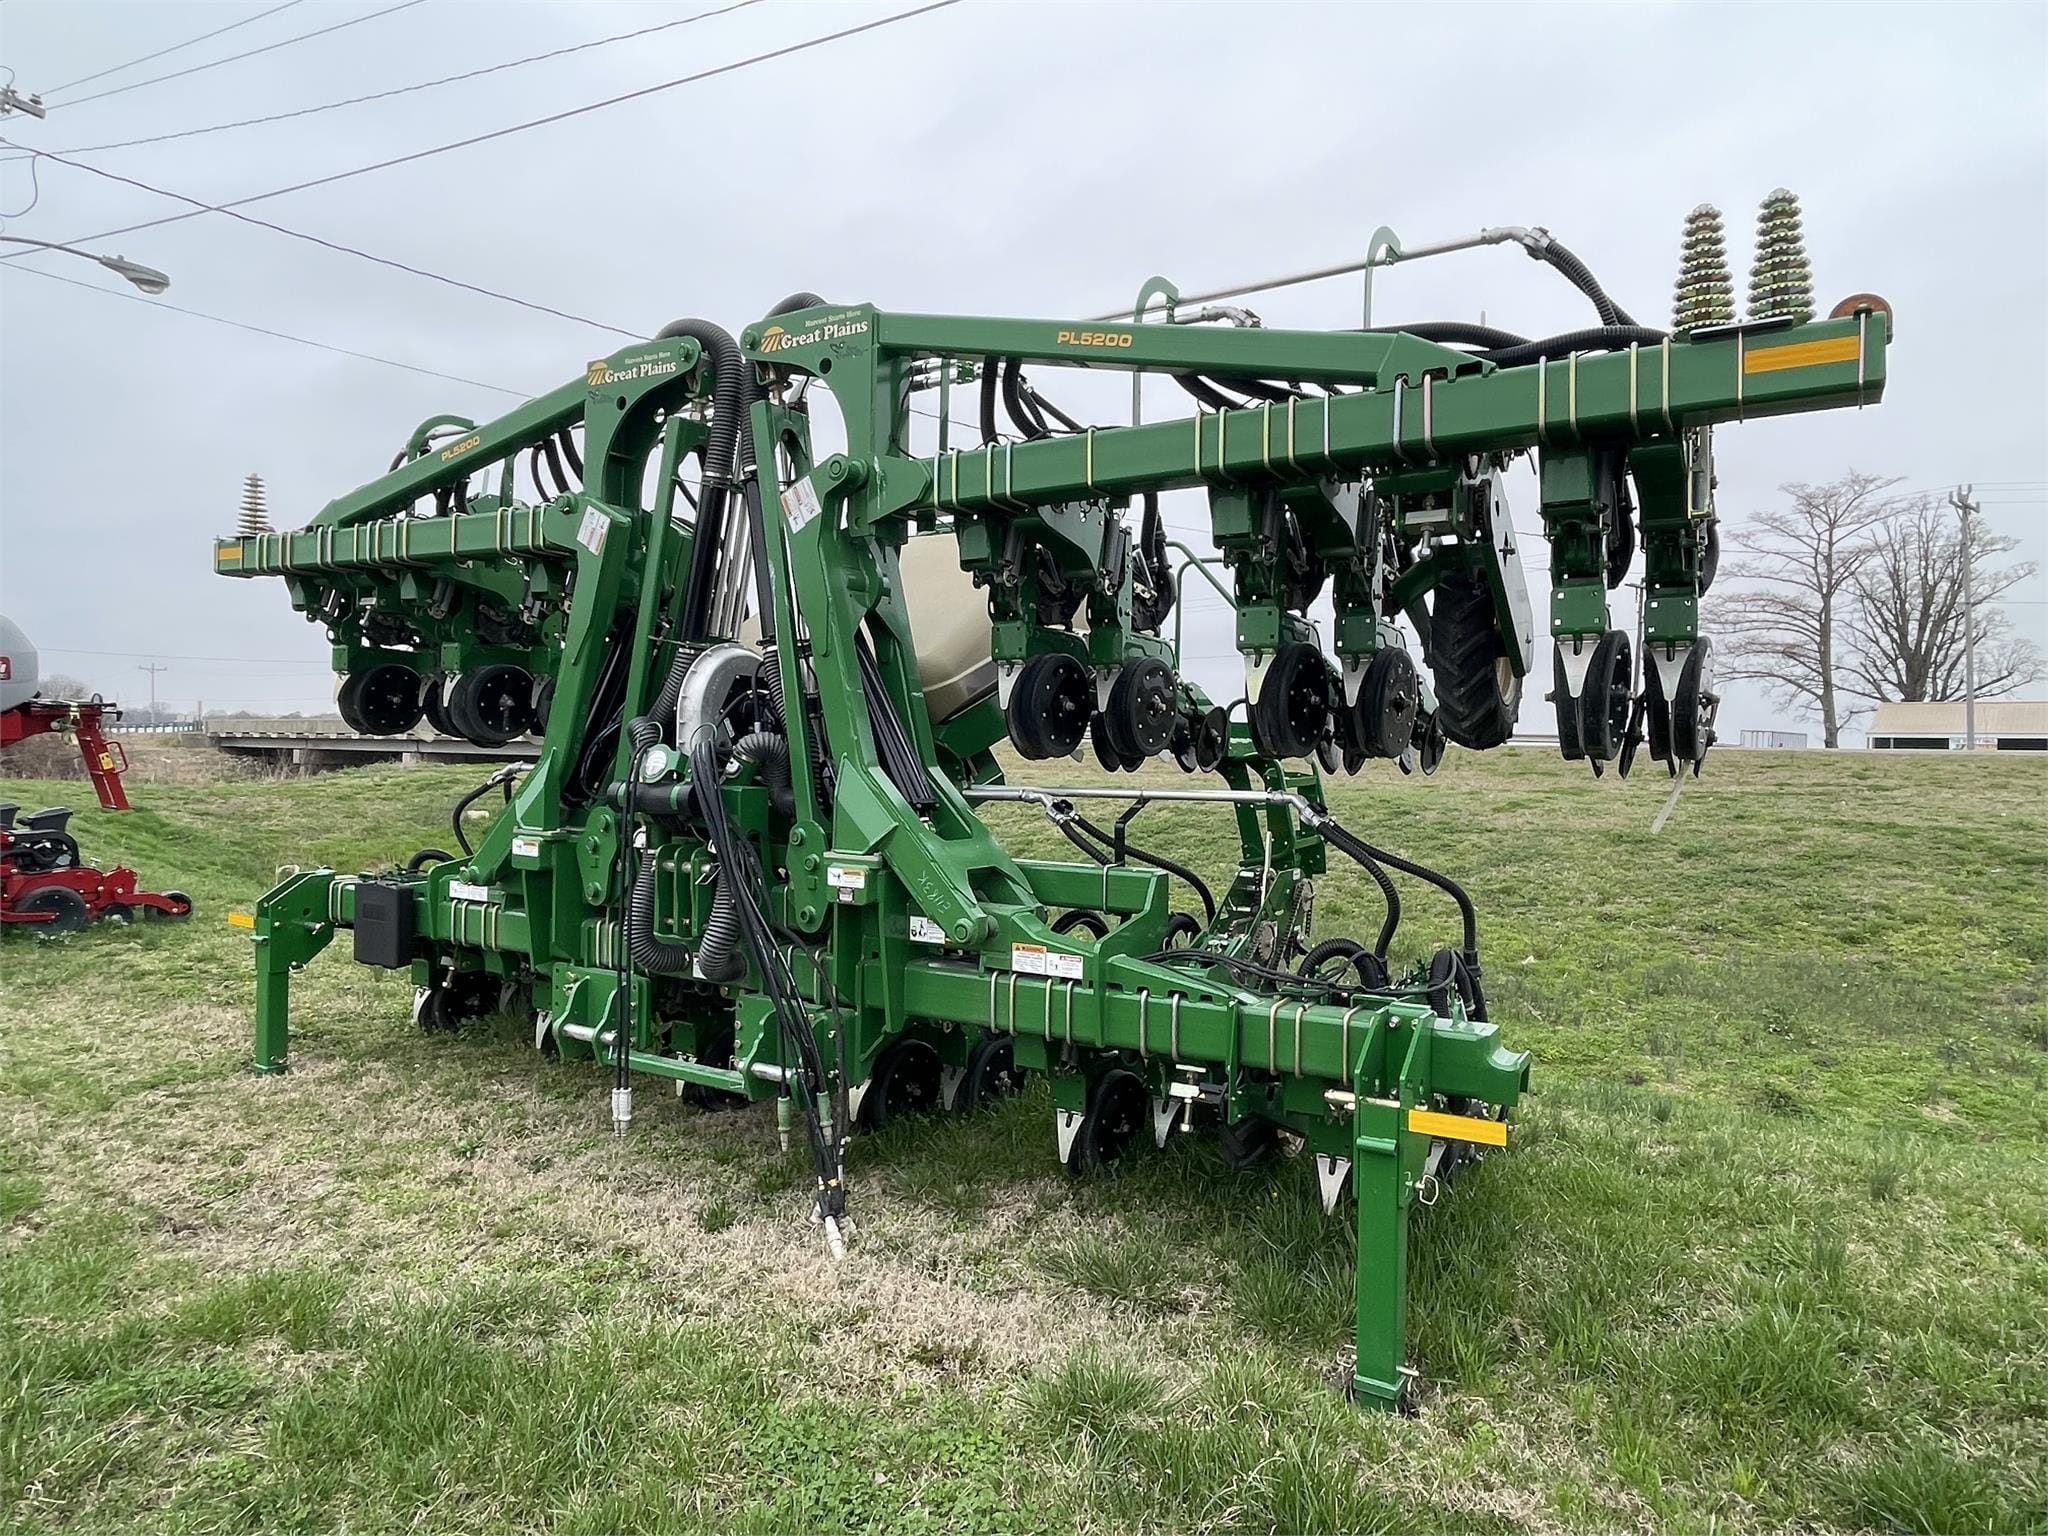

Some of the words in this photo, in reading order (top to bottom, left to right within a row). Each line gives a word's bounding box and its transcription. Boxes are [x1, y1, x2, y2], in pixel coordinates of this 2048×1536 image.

[781, 328, 821, 349] Great
[823, 320, 869, 340] Plains
[1056, 331, 1133, 348] PL5200
[604, 367, 638, 384] Great
[639, 361, 677, 378] Plains
[441, 435, 480, 462] PL5200
